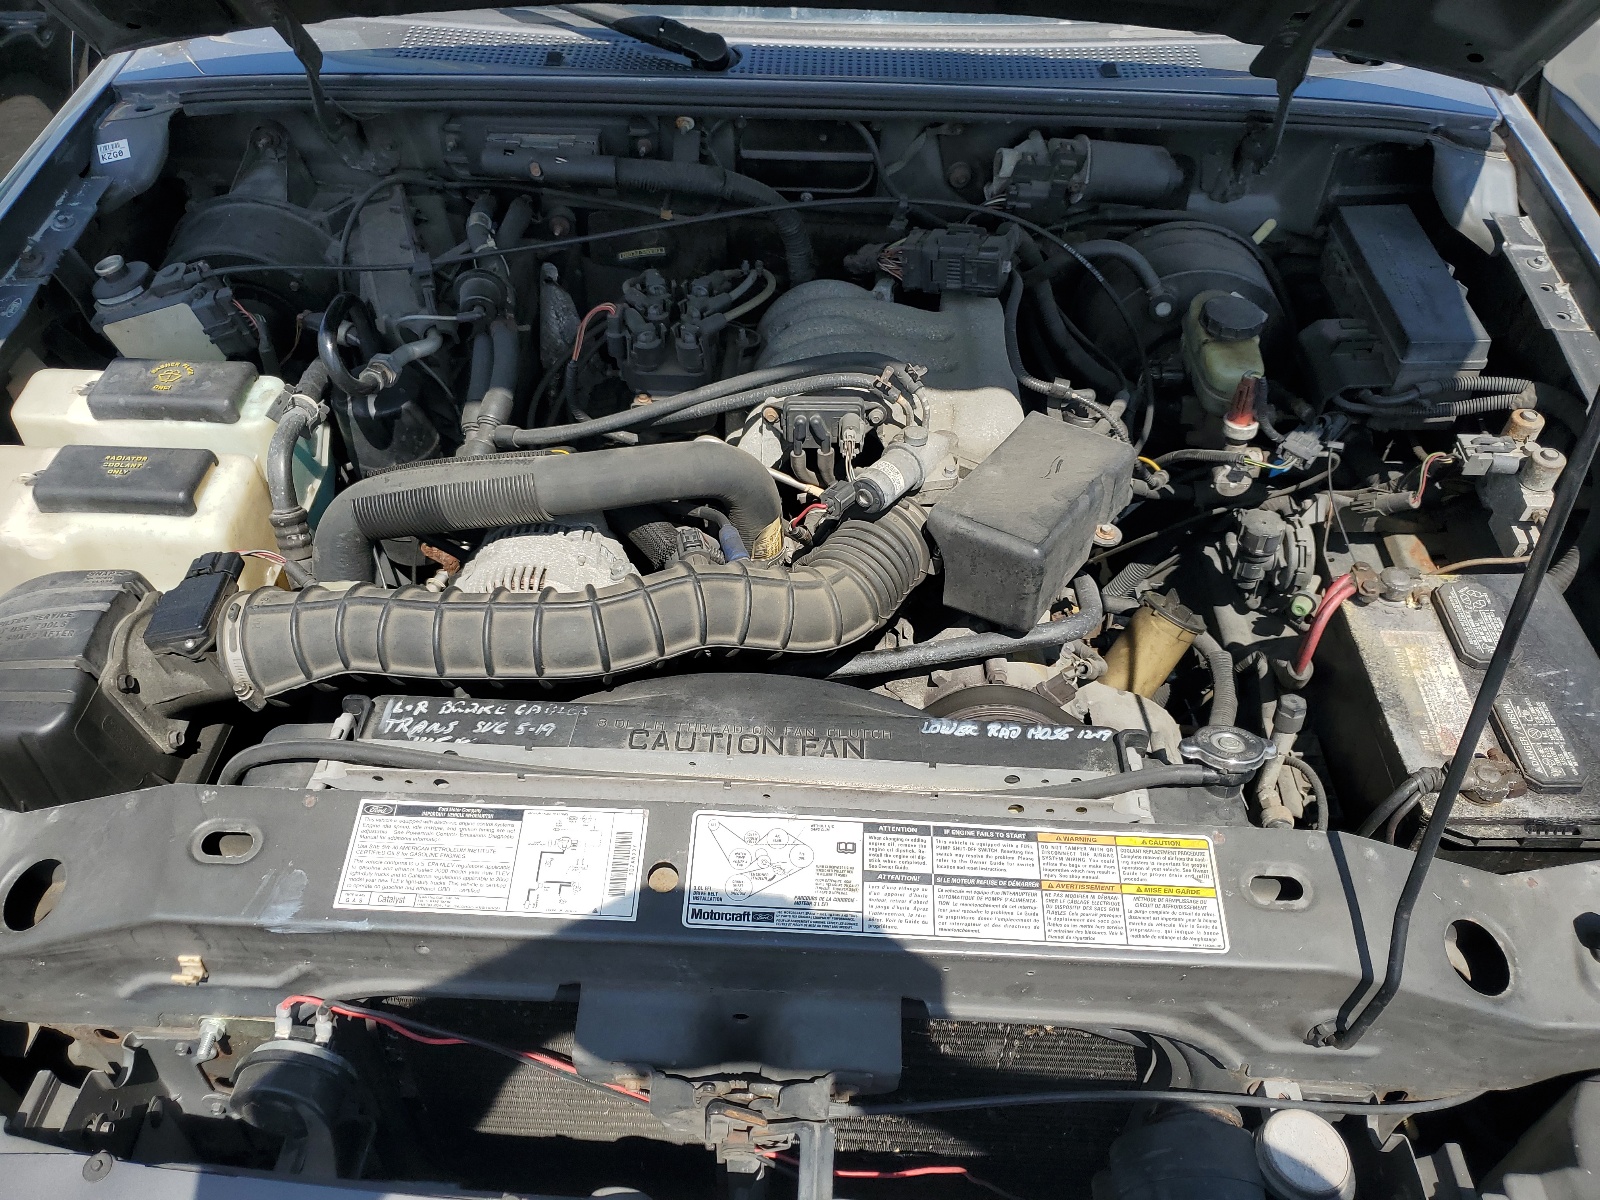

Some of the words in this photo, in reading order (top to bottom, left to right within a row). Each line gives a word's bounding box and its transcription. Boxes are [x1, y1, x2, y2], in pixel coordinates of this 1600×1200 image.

[385, 719, 459, 734] TRANS
[675, 722, 743, 734] THREAD
[753, 726, 776, 736] ON
[785, 726, 816, 737] FAN
[827, 729, 893, 739] CLUTCH
[921, 721, 980, 736] LOWER
[987, 724, 1022, 739] RAD
[1027, 727, 1075, 740] HOSE
[628, 729, 785, 755] CAUTION
[801, 737, 866, 759] FAN
[876, 873, 920, 882] ATTENTION!
[1055, 882, 1115, 891] AVERTISSEMENT
[376, 894, 405, 903] Catalyst
[690, 907, 751, 922] Motorcraft
